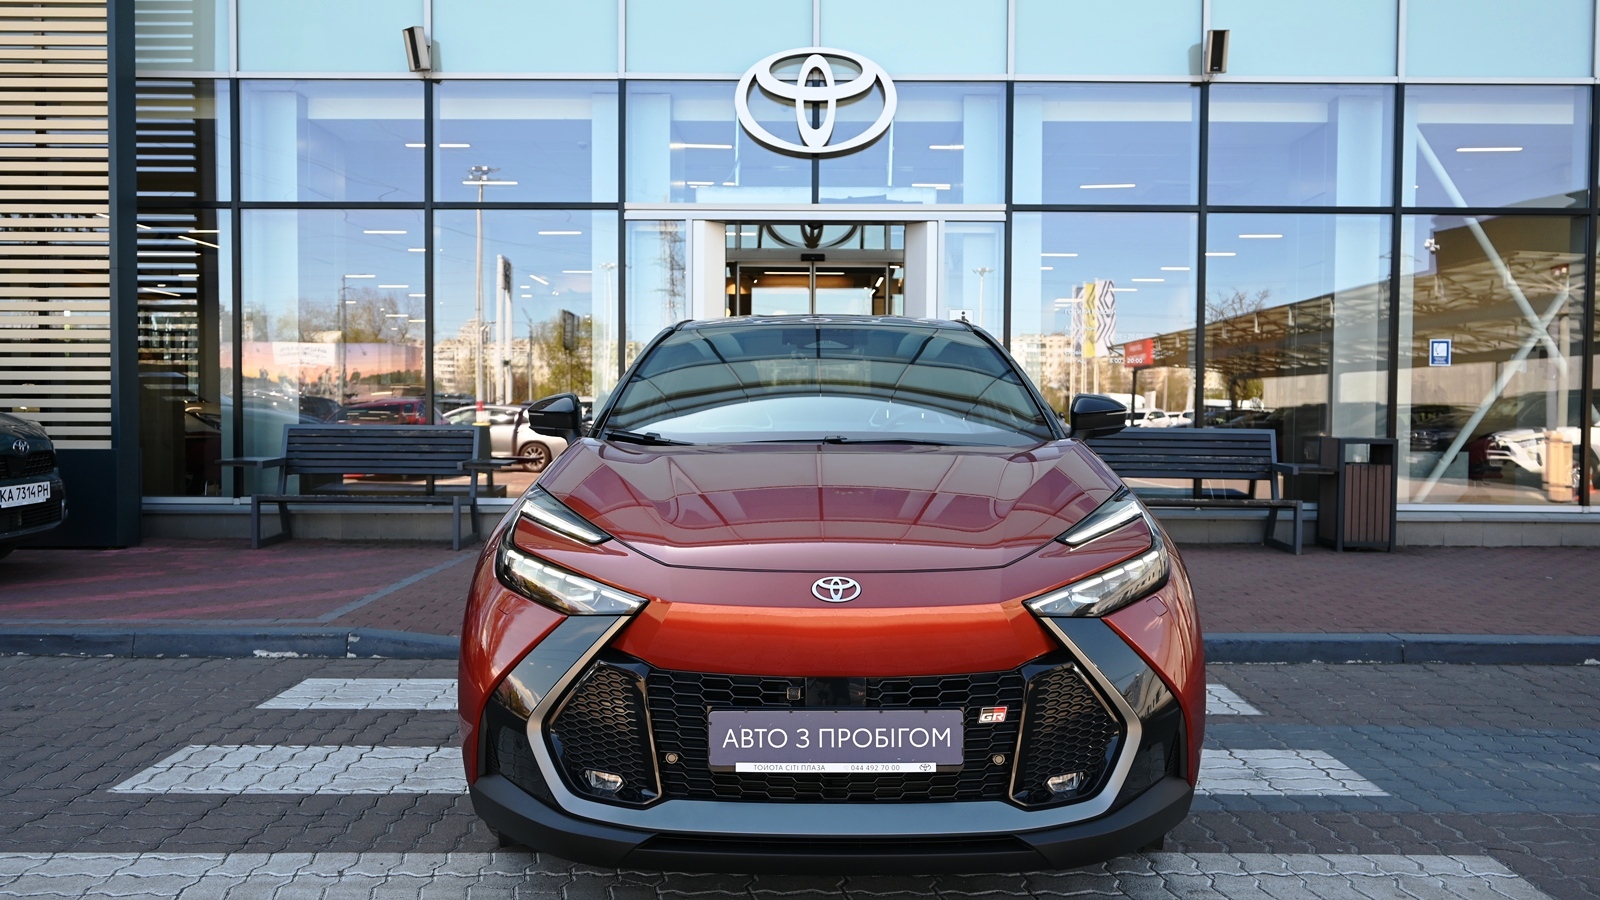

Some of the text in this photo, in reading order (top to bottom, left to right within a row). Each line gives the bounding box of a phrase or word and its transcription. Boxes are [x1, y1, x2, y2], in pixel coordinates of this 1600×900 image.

[16, 486, 36, 500] 7314
[37, 484, 49, 497] PH
[981, 713, 1005, 721] GR
[722, 727, 951, 748] АВТО З ПРОБІГОМ
